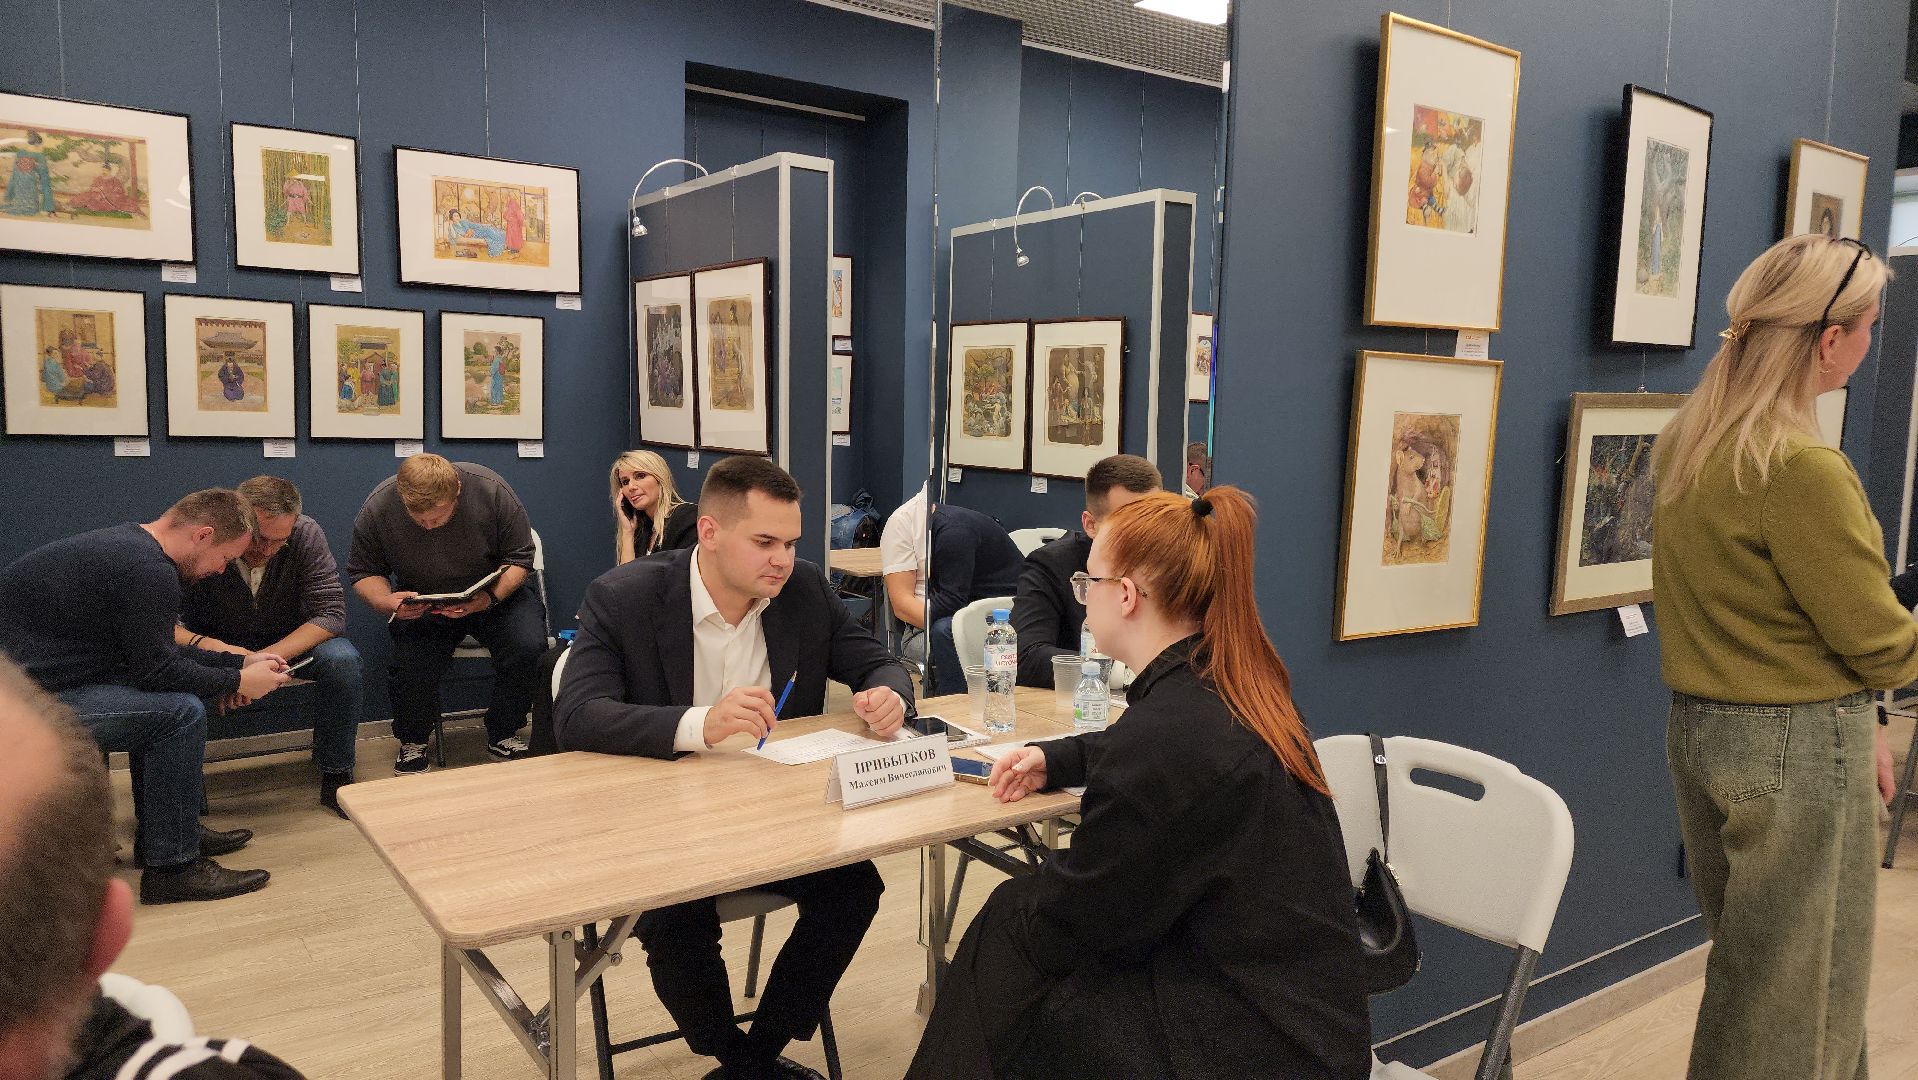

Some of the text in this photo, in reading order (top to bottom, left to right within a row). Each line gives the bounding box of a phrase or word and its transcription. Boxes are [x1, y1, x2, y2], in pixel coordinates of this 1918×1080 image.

[855, 749, 936, 774] ПРИБЫТКОВ
[849, 764, 947, 790] Максим Вячеславович
